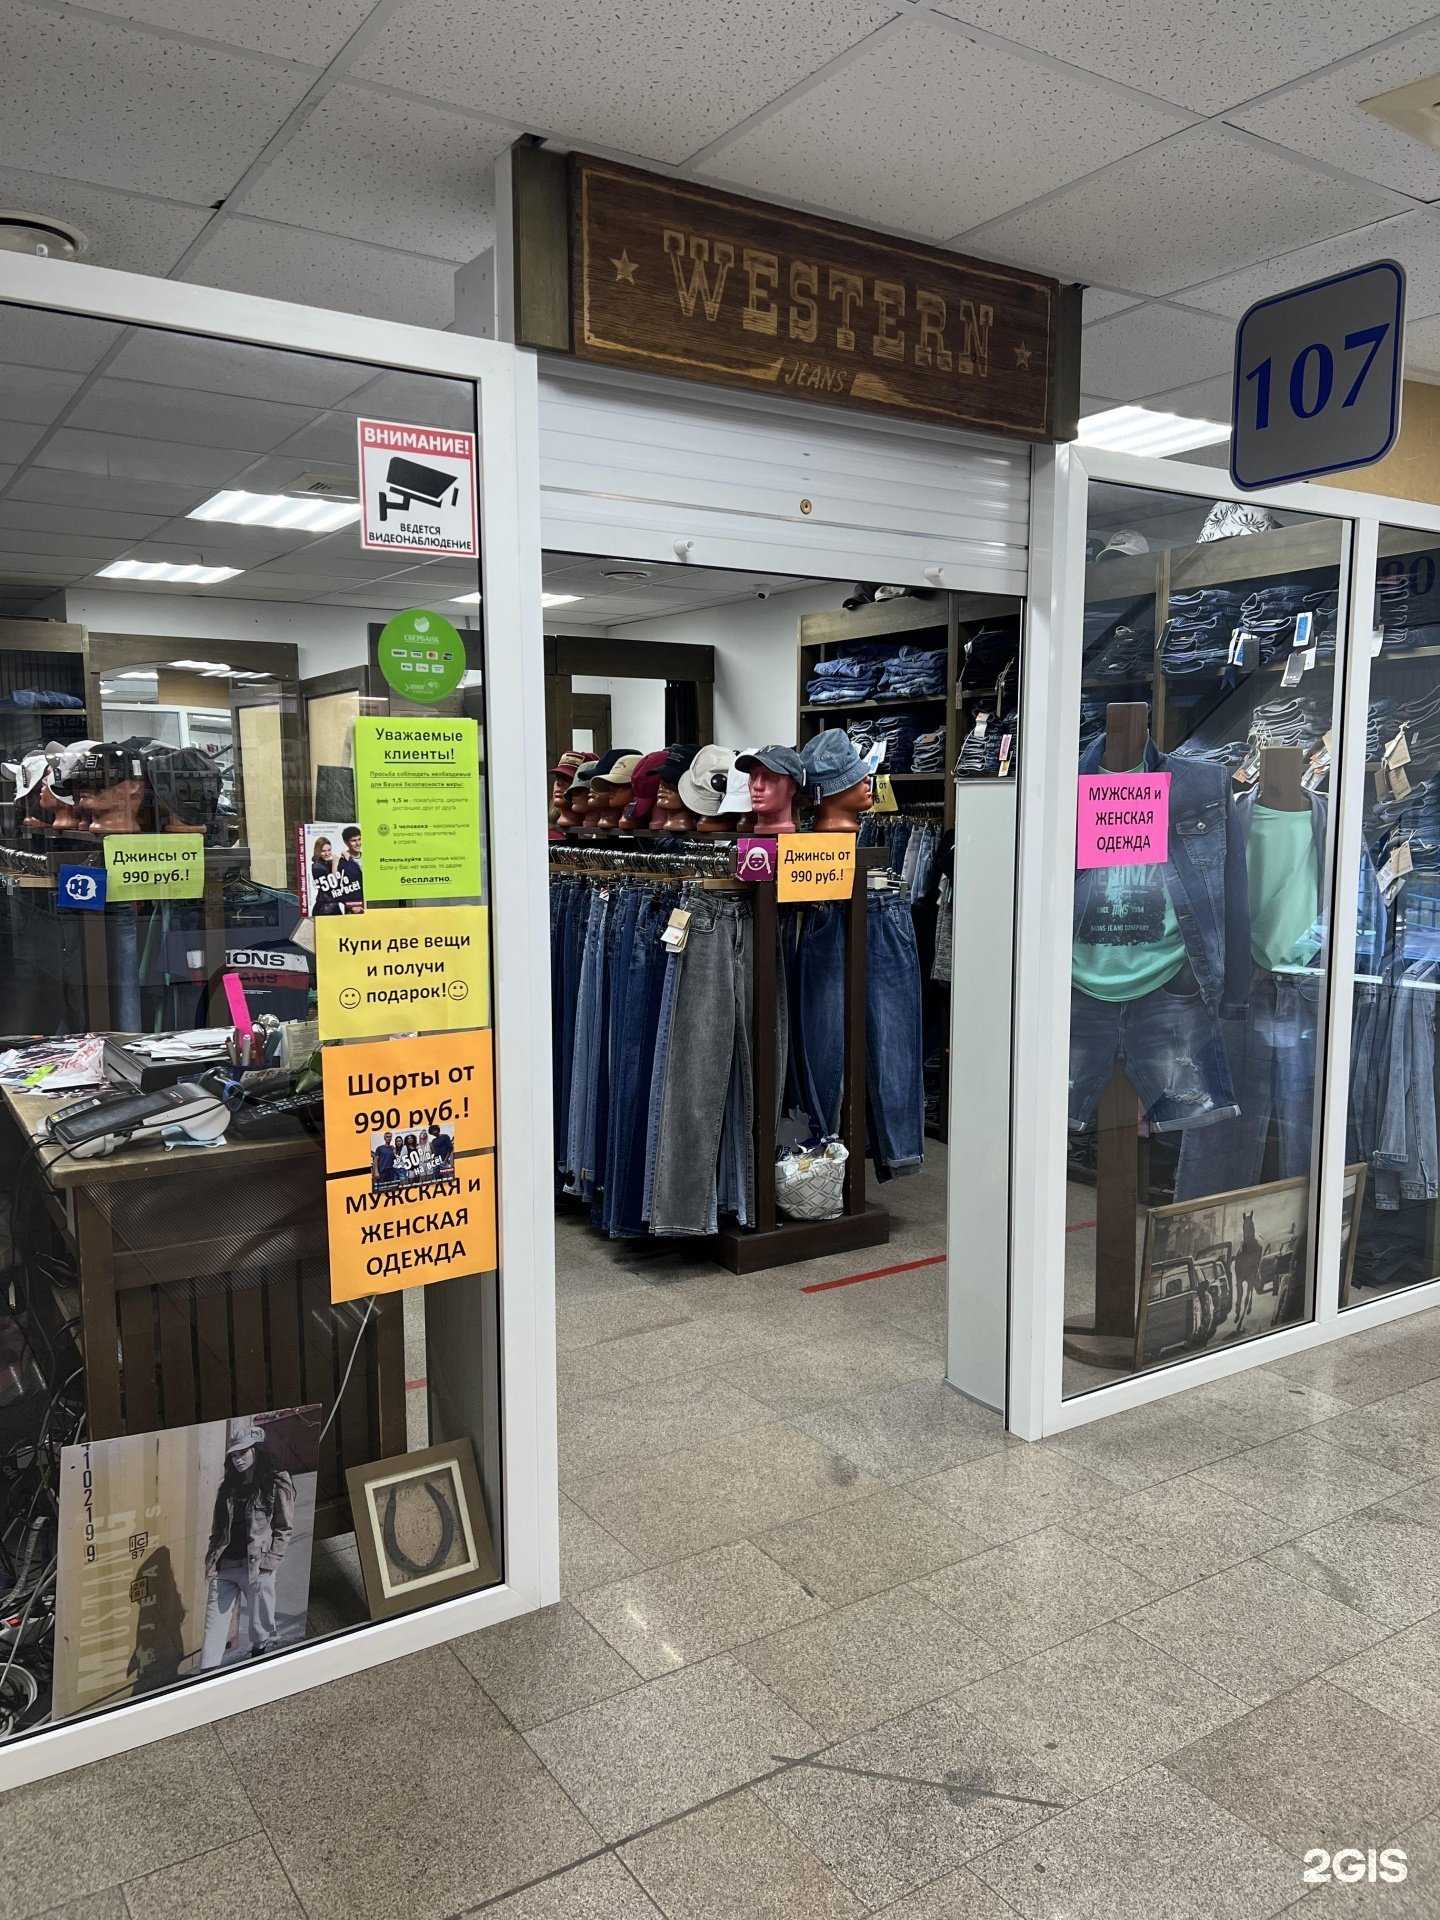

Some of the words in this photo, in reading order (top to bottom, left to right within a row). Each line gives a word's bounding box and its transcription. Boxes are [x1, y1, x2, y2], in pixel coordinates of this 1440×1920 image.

[663, 229, 994, 378] WESTERN
[785, 359, 848, 393] JEANS
[1246, 322, 1391, 430] 107
[364, 427, 470, 455] ВНИМАНИЕ!
[400, 523, 441, 535] ВЕДЕТСЯ
[368, 532, 472, 550] ВИДЕОНАБЛЮДЕНИЕ
[375, 728, 463, 741] Уважаемые
[384, 748, 455, 760] клиенты!
[1089, 786, 1151, 801] МУЖСКАЯ
[1155, 790, 1162, 800] и
[1095, 811, 1154, 826] ЖЕНСКАЯ
[1097, 835, 1151, 852] ОДЕЖДА
[113, 851, 177, 865] Джинсы
[182, 851, 198, 861] от
[784, 850, 835, 864] Джинсы
[838, 851, 851, 861] от
[123, 871, 149, 883] 990
[154, 869, 190, 884] руб.!
[791, 870, 812, 883] 990
[816, 869, 844, 884] руб.!
[339, 937, 382, 956] Купи
[387, 937, 419, 953] две
[425, 934, 470, 949] вещи
[367, 966, 377, 977] и
[384, 961, 445, 978] получи
[367, 982, 446, 1004] подарок!
[347, 1068, 440, 1097] Шорты
[448, 1065, 475, 1083] от
[354, 1107, 401, 1134] 990
[409, 1096, 469, 1128] руб.!
[468, 1178, 481, 1193] и
[360, 1208, 468, 1245] ЖЕНСКАЯ
[366, 1240, 466, 1277] ОДЕЖДА
